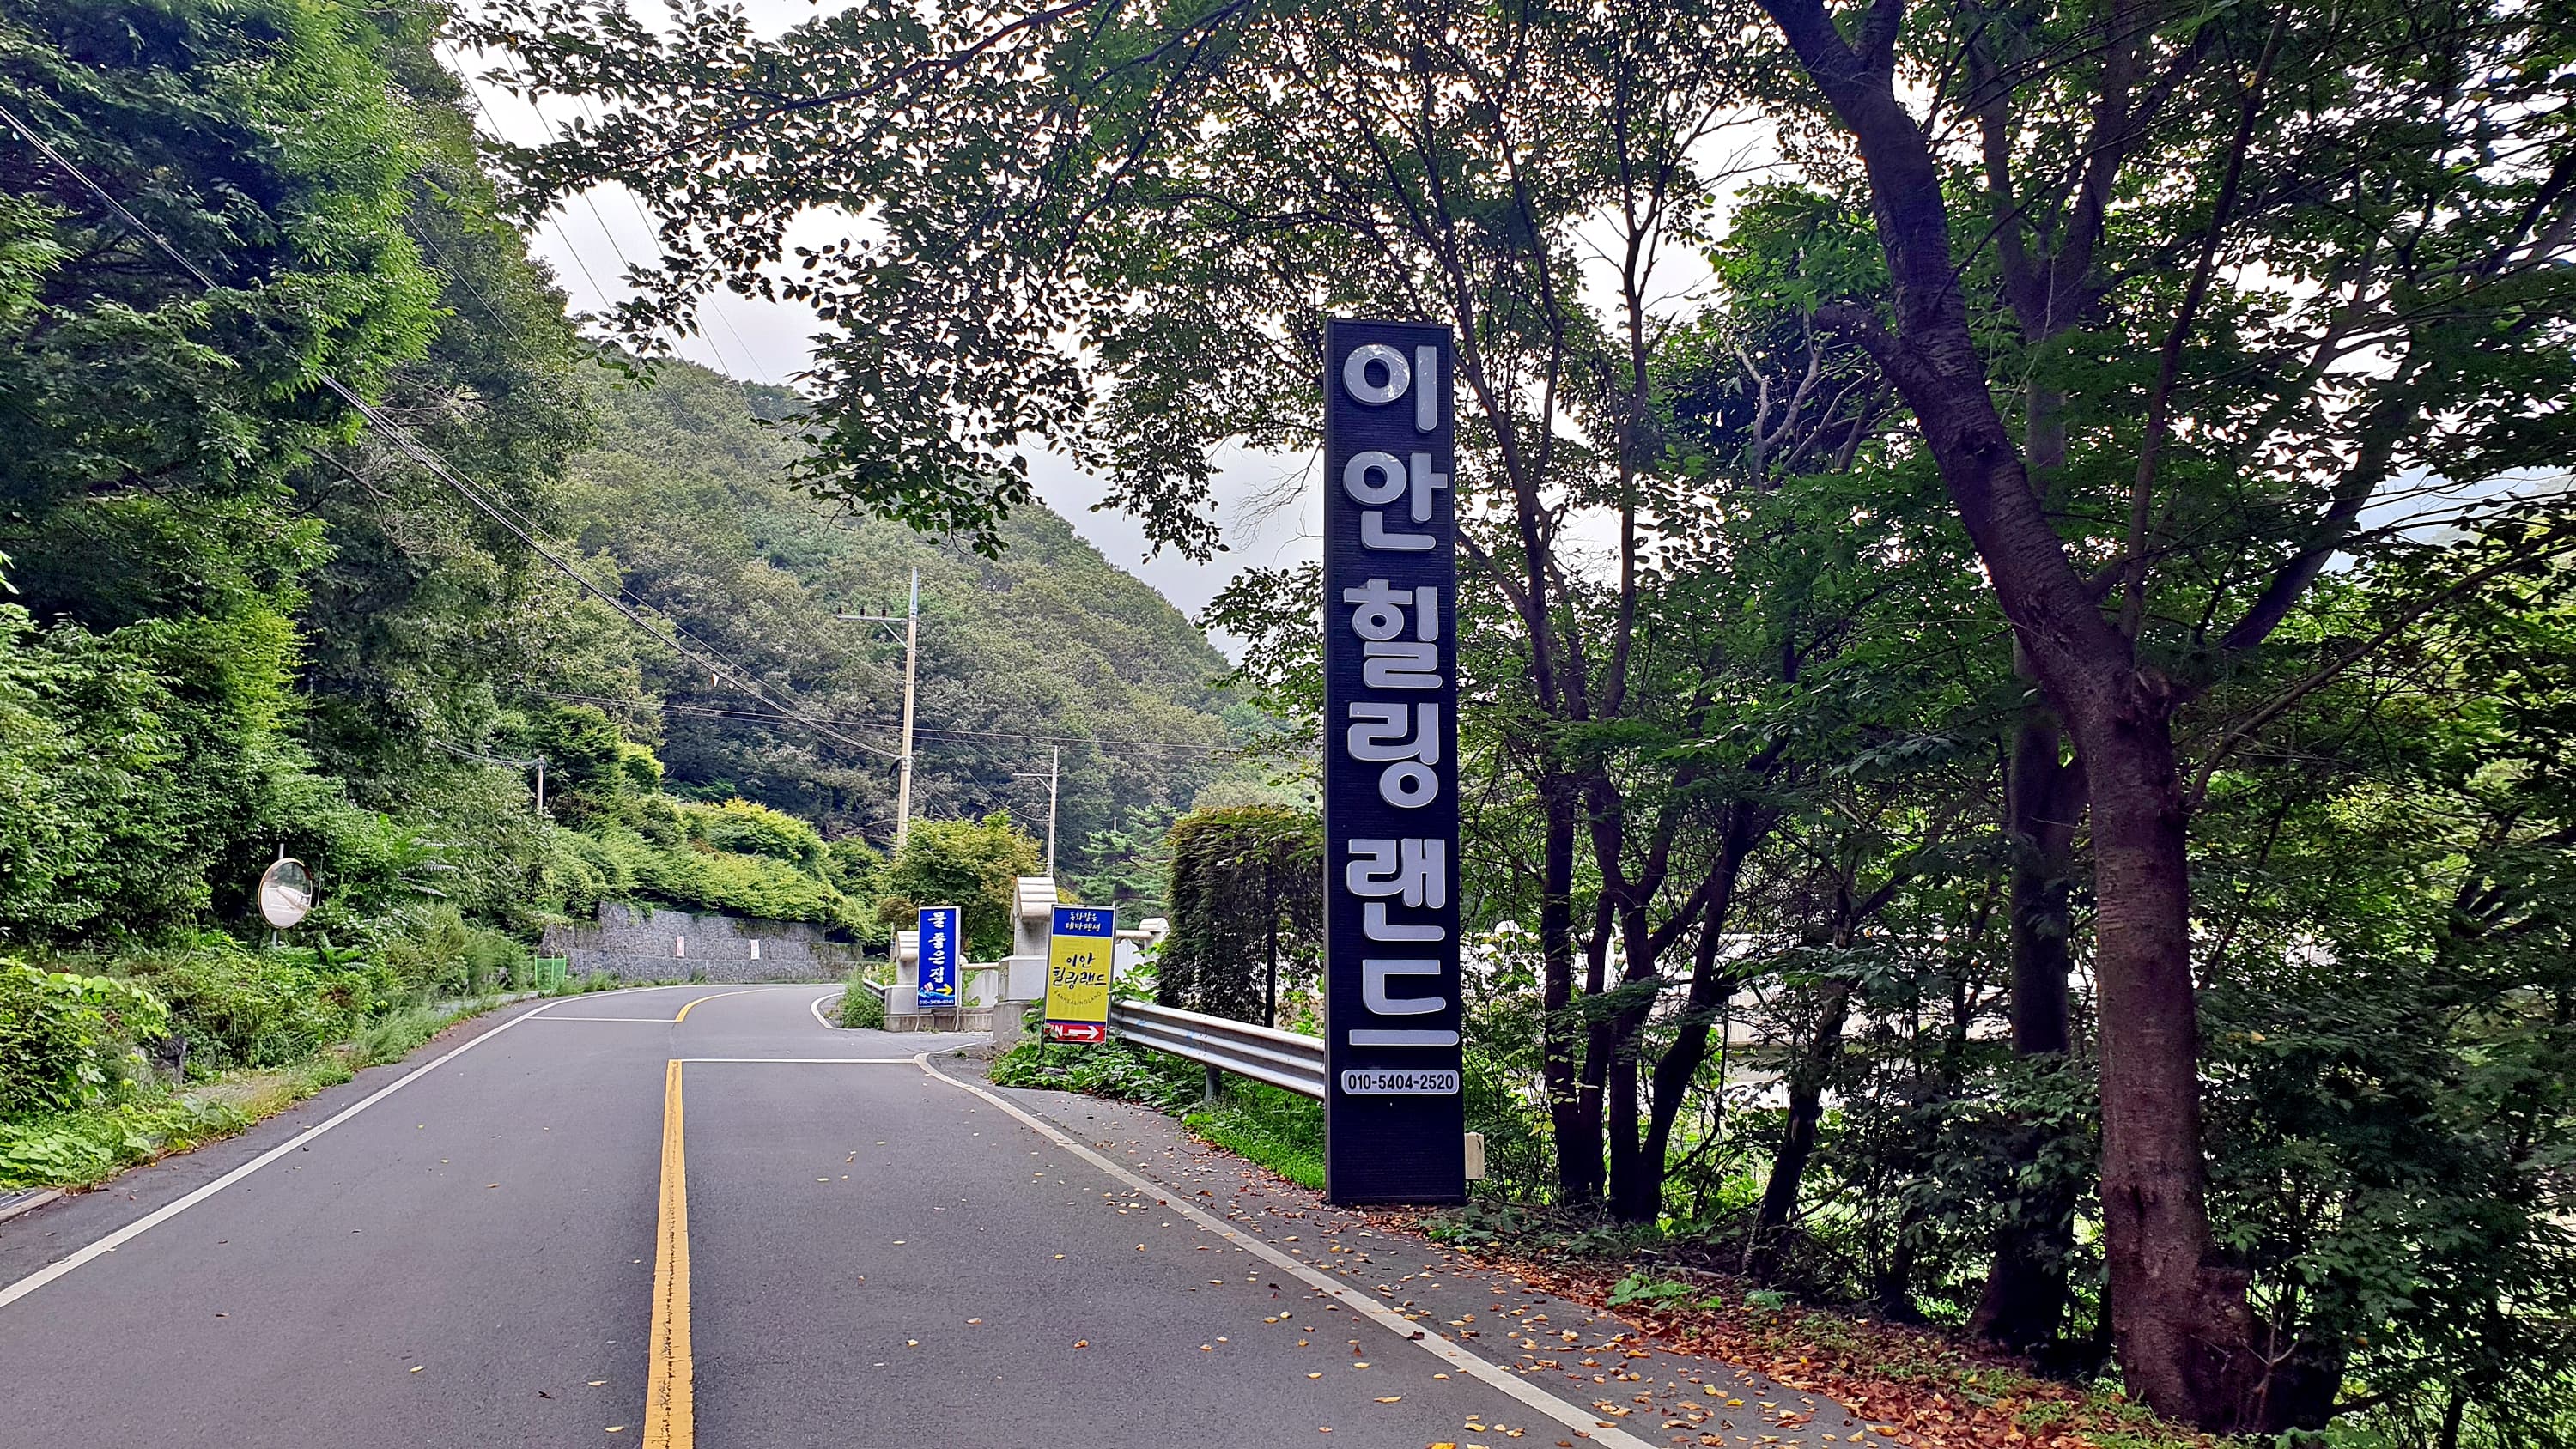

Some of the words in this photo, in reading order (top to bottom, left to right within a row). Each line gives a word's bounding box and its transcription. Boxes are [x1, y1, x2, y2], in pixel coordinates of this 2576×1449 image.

[1066, 952, 1096, 968] 이안
[1053, 967, 1107, 990] 힐링랜드
[1348, 1074, 1454, 1090] 010-5404-2520
